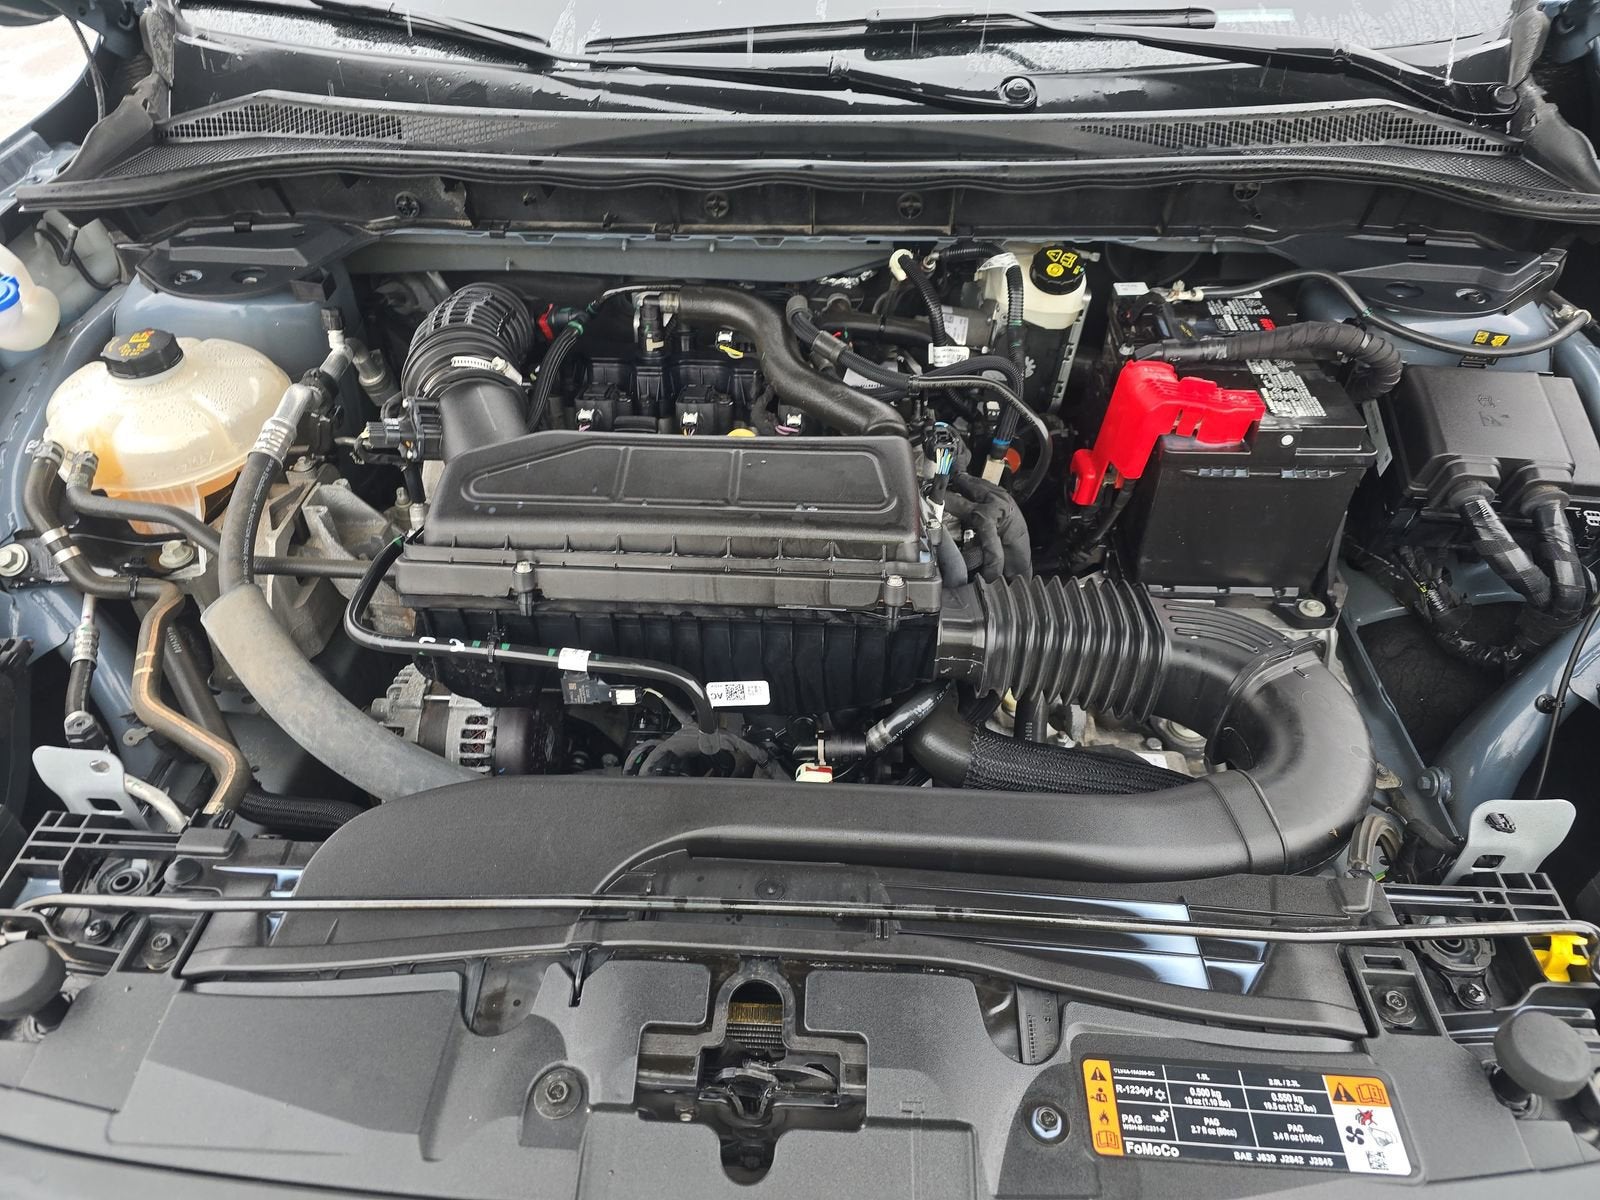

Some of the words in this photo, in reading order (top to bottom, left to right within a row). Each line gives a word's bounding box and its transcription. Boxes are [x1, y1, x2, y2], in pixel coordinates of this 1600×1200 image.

[1115, 1084, 1154, 1097] R-1234yf
[1210, 1088, 1222, 1100] kg
[1291, 1093, 1304, 1105] kg
[1121, 1113, 1143, 1124] PAG
[1203, 1116, 1220, 1127] PAG
[1286, 1123, 1304, 1133] PAG
[1125, 1141, 1180, 1157] FoMoCo
[1233, 1150, 1254, 1162] SAE
[1255, 1152, 1277, 1163] J639
